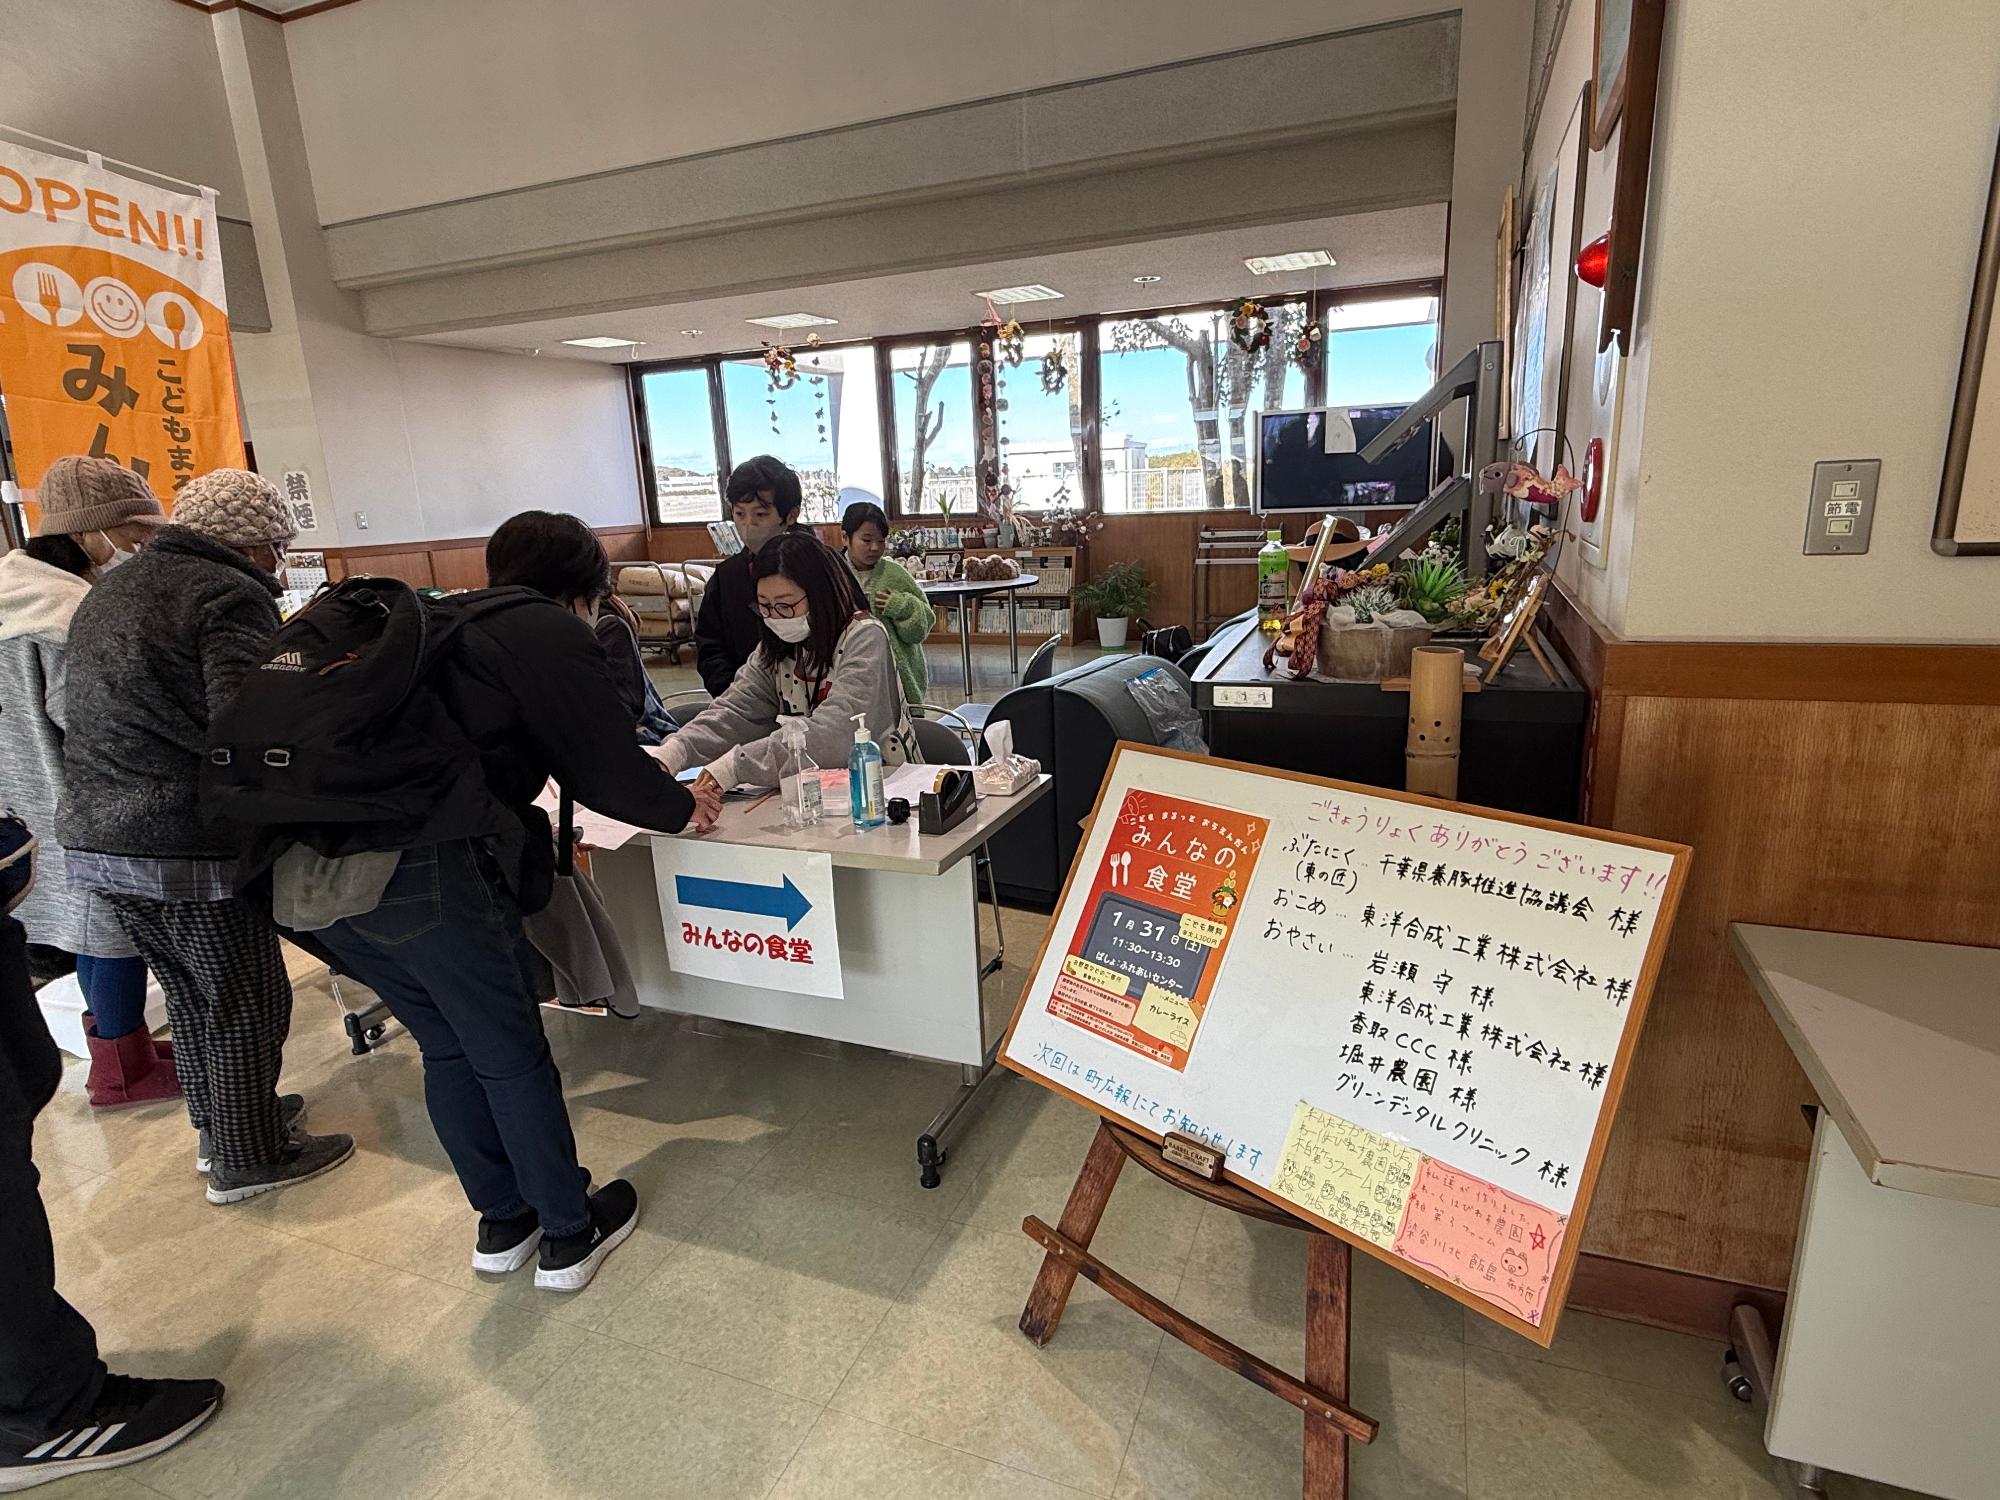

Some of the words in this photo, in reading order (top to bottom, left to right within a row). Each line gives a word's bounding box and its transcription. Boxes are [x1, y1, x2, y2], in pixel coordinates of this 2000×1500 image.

[0, 165, 204, 261] OPEN!!
[286, 473, 315, 529] 禁煙
[1827, 502, 1859, 515] 節電
[1131, 825, 1236, 869] みんなの
[1143, 865, 1197, 900] 食堂
[1380, 854, 1595, 921] 千葉県養豚推進協議会
[1608, 906, 1643, 939] 様
[682, 922, 814, 965] みんなの食堂
[1361, 902, 1598, 991] 東洋合成工業株式会社
[1604, 976, 1633, 1008] 様
[1367, 950, 1420, 984] 岩瀬
[1433, 969, 1454, 995] 守
[1470, 985, 1496, 1012] 様
[1149, 1004, 1190, 1027] カレーライス
[1359, 980, 1572, 1073] 東洋合成工業株式会社
[1579, 1061, 1609, 1091] 様
[1339, 1044, 1438, 1095] 堀井農園
[1449, 1086, 1478, 1113] 様
[1448, 1049, 1473, 1077] 様
[1537, 1160, 1572, 1190] 様
